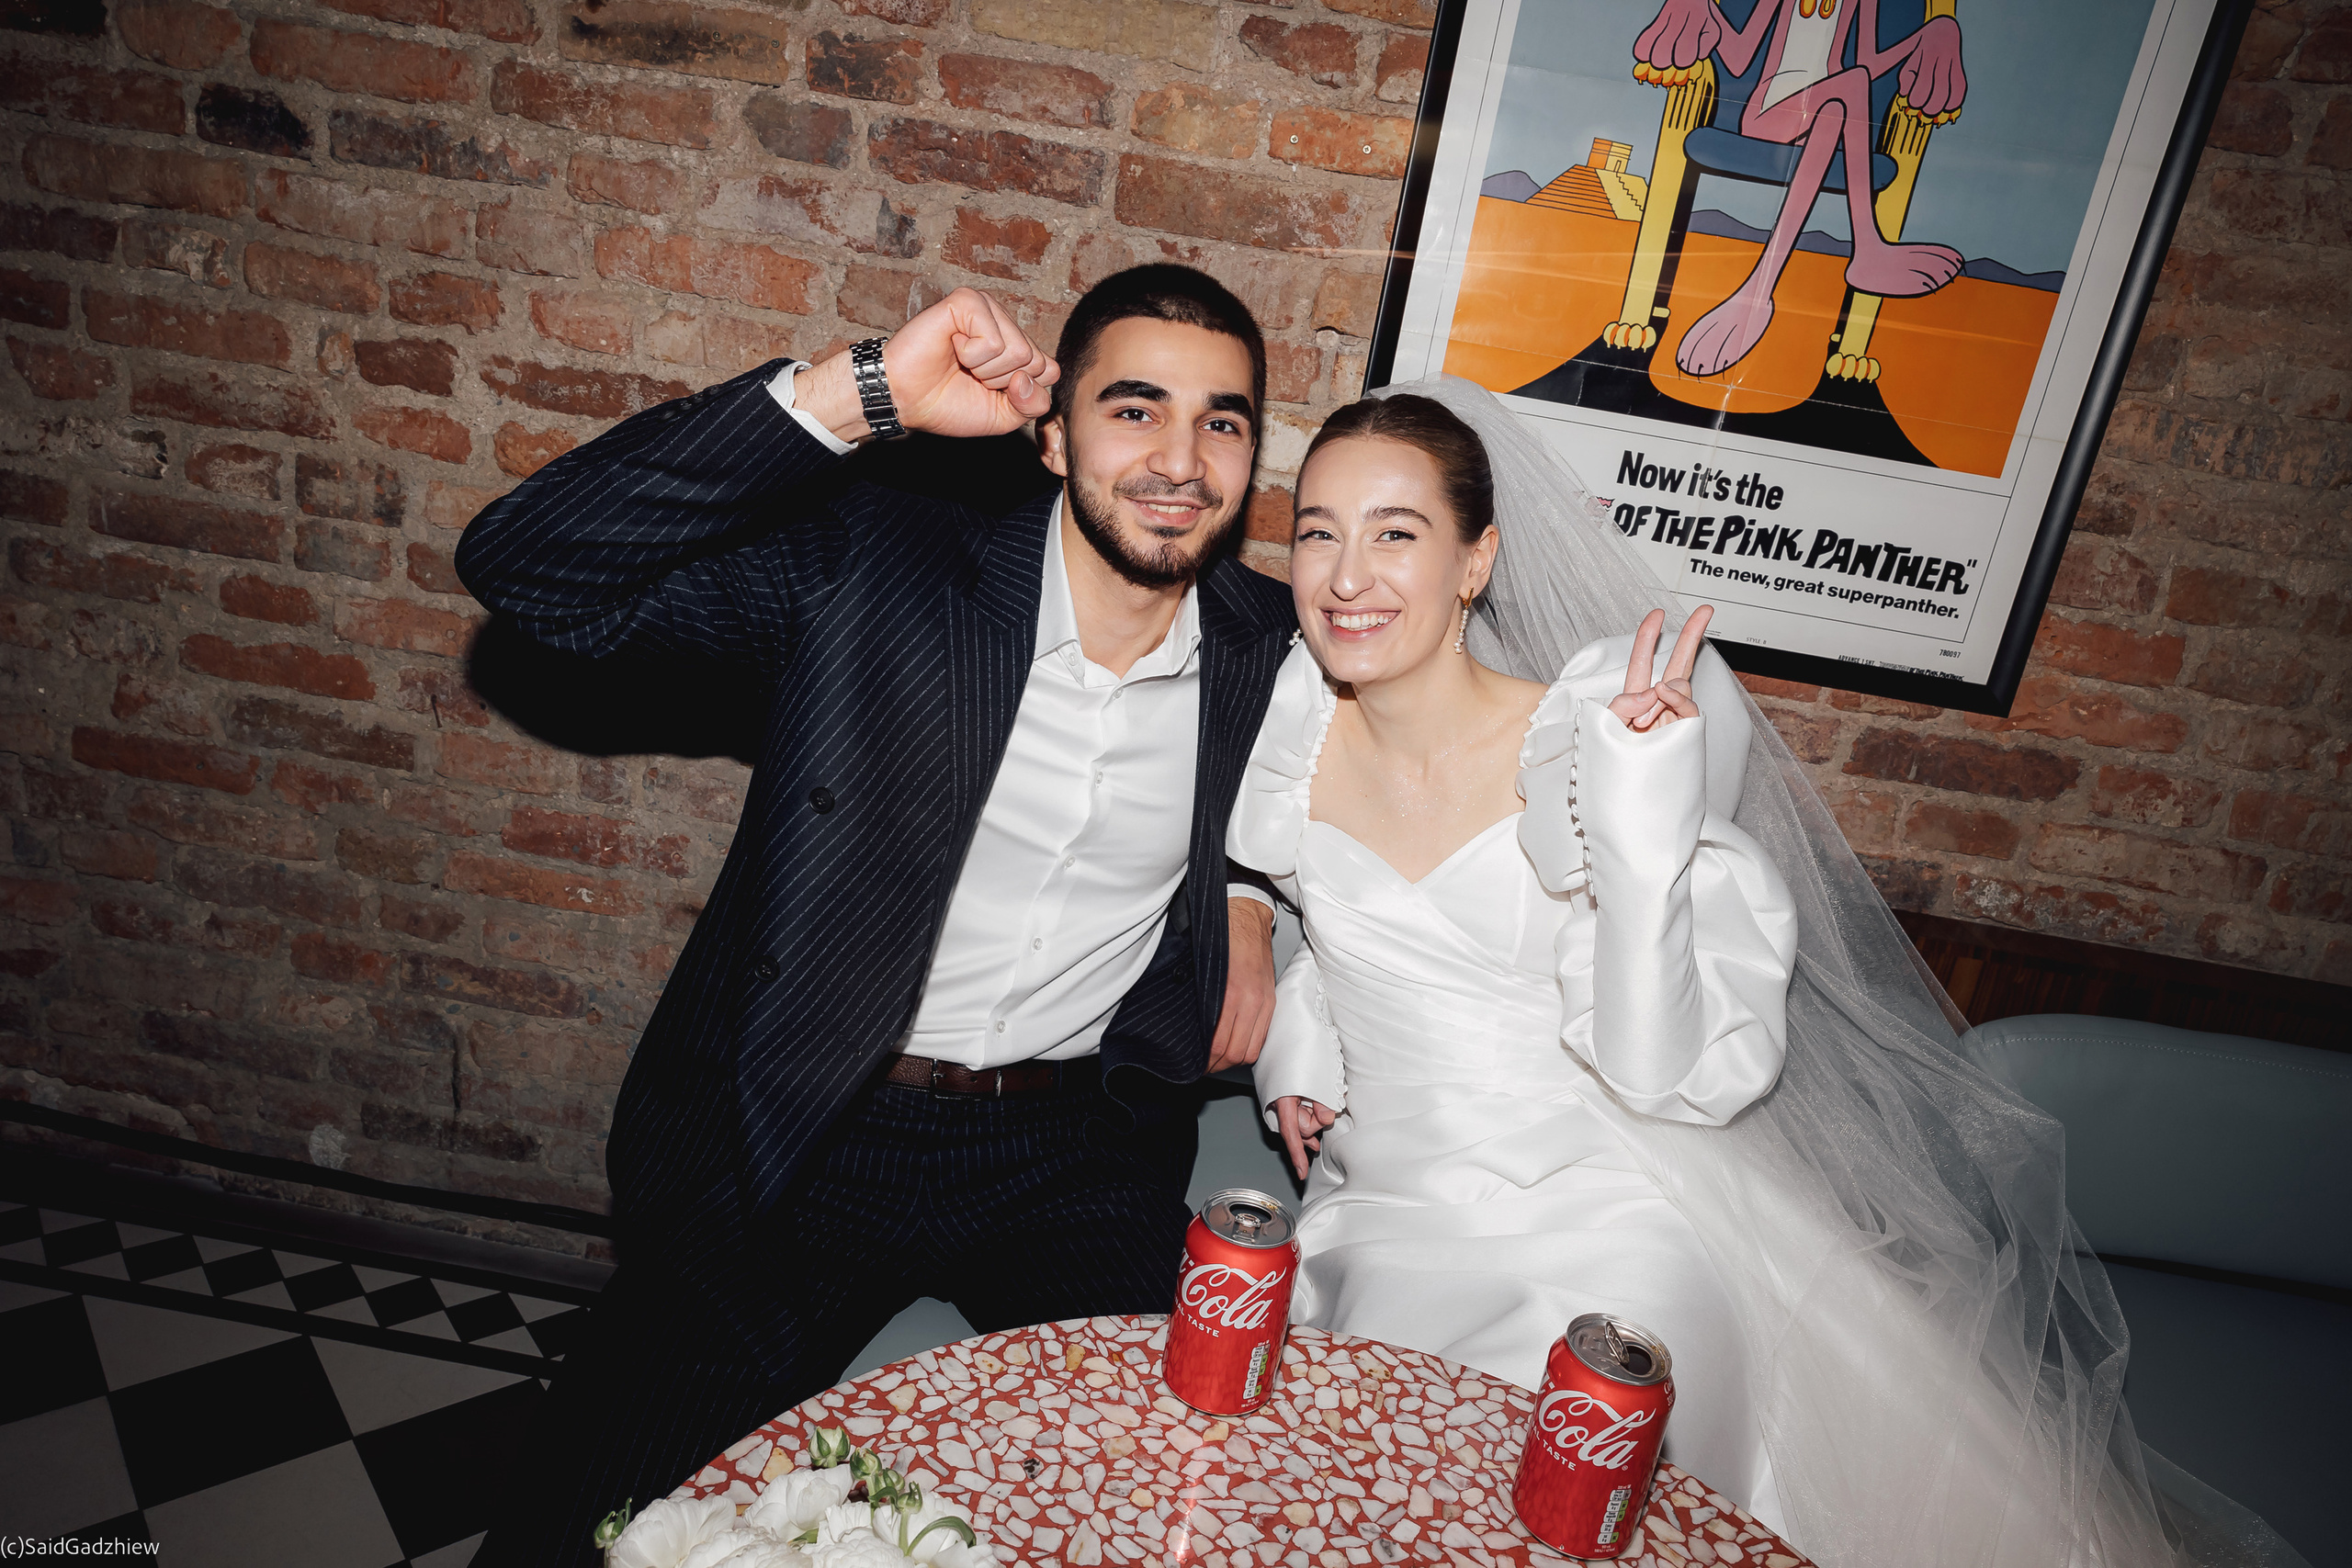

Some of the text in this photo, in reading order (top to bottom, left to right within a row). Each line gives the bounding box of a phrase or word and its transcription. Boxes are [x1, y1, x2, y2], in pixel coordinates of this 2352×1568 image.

[1616, 449, 1784, 511] Now it's the
[1613, 502, 1653, 537] OF
[1650, 505, 1716, 549] THE
[1690, 558, 1960, 619] The new, great superpanther.
[1939, 649, 1962, 659] 780097
[1181, 1263, 1286, 1330] Cola
[1187, 1314, 1220, 1337] TASTE
[1538, 1389, 1657, 1470] Cola
[1543, 1438, 1577, 1471] TASTE
